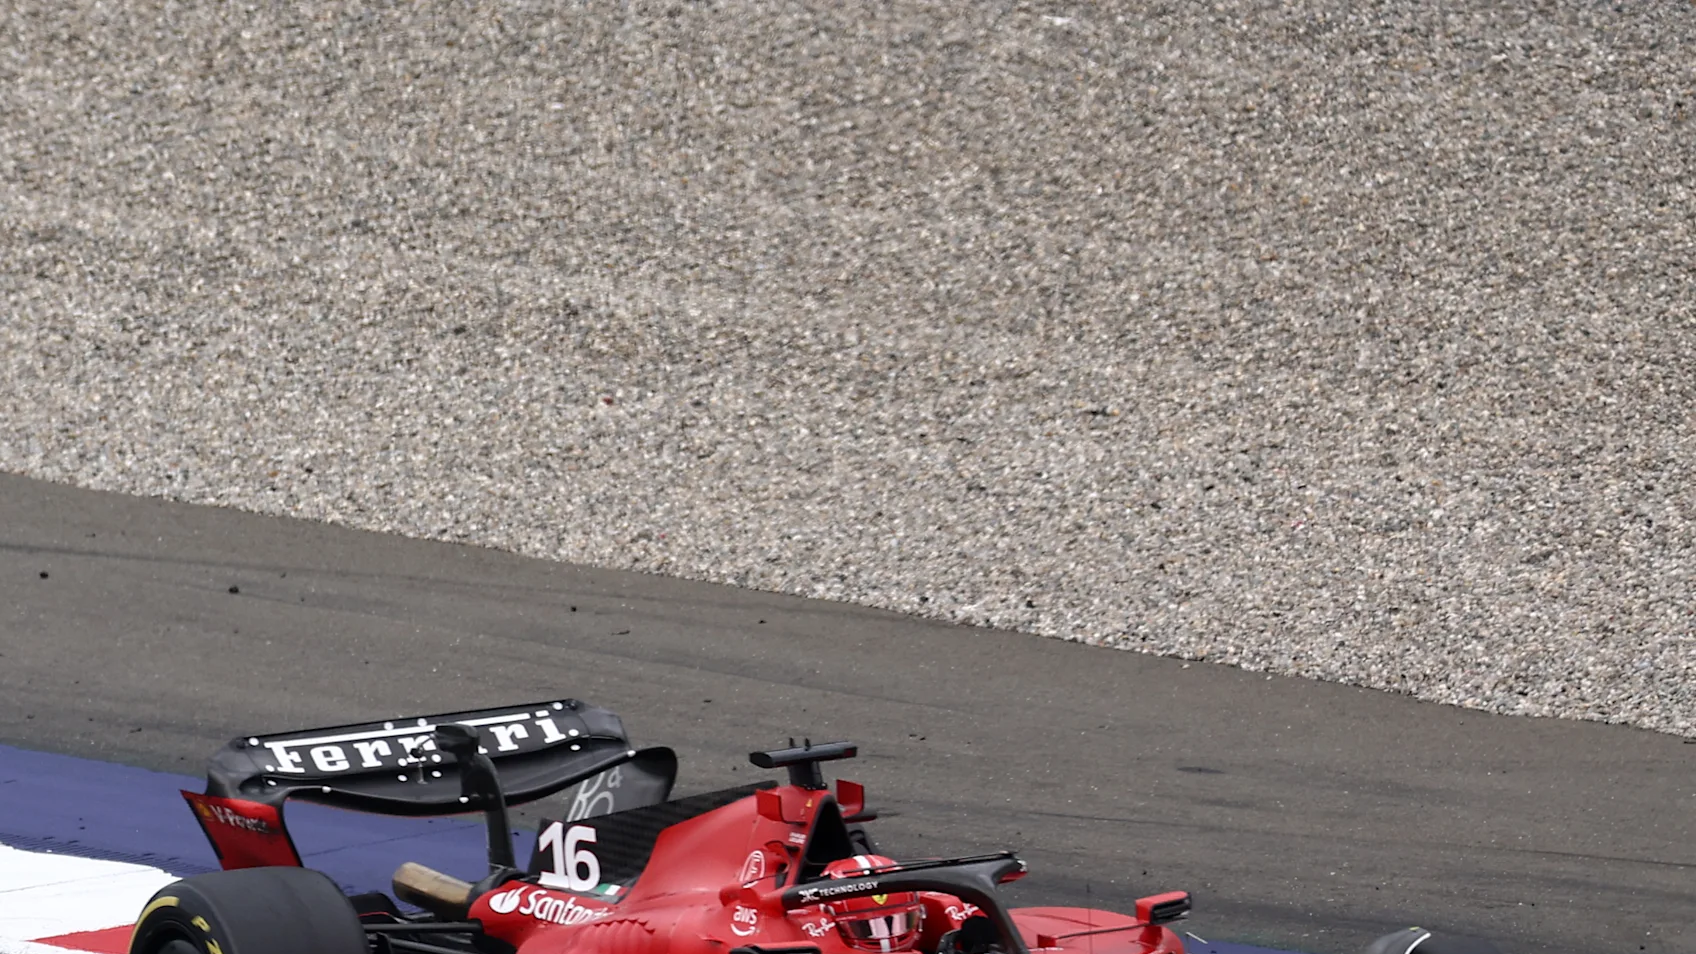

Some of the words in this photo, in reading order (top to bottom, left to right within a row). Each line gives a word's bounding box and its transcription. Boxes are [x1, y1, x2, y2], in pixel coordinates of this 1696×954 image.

[264, 710, 566, 772] Ferrri
[538, 822, 600, 891] 16
[819, 881, 878, 897] TECHNOLOGY
